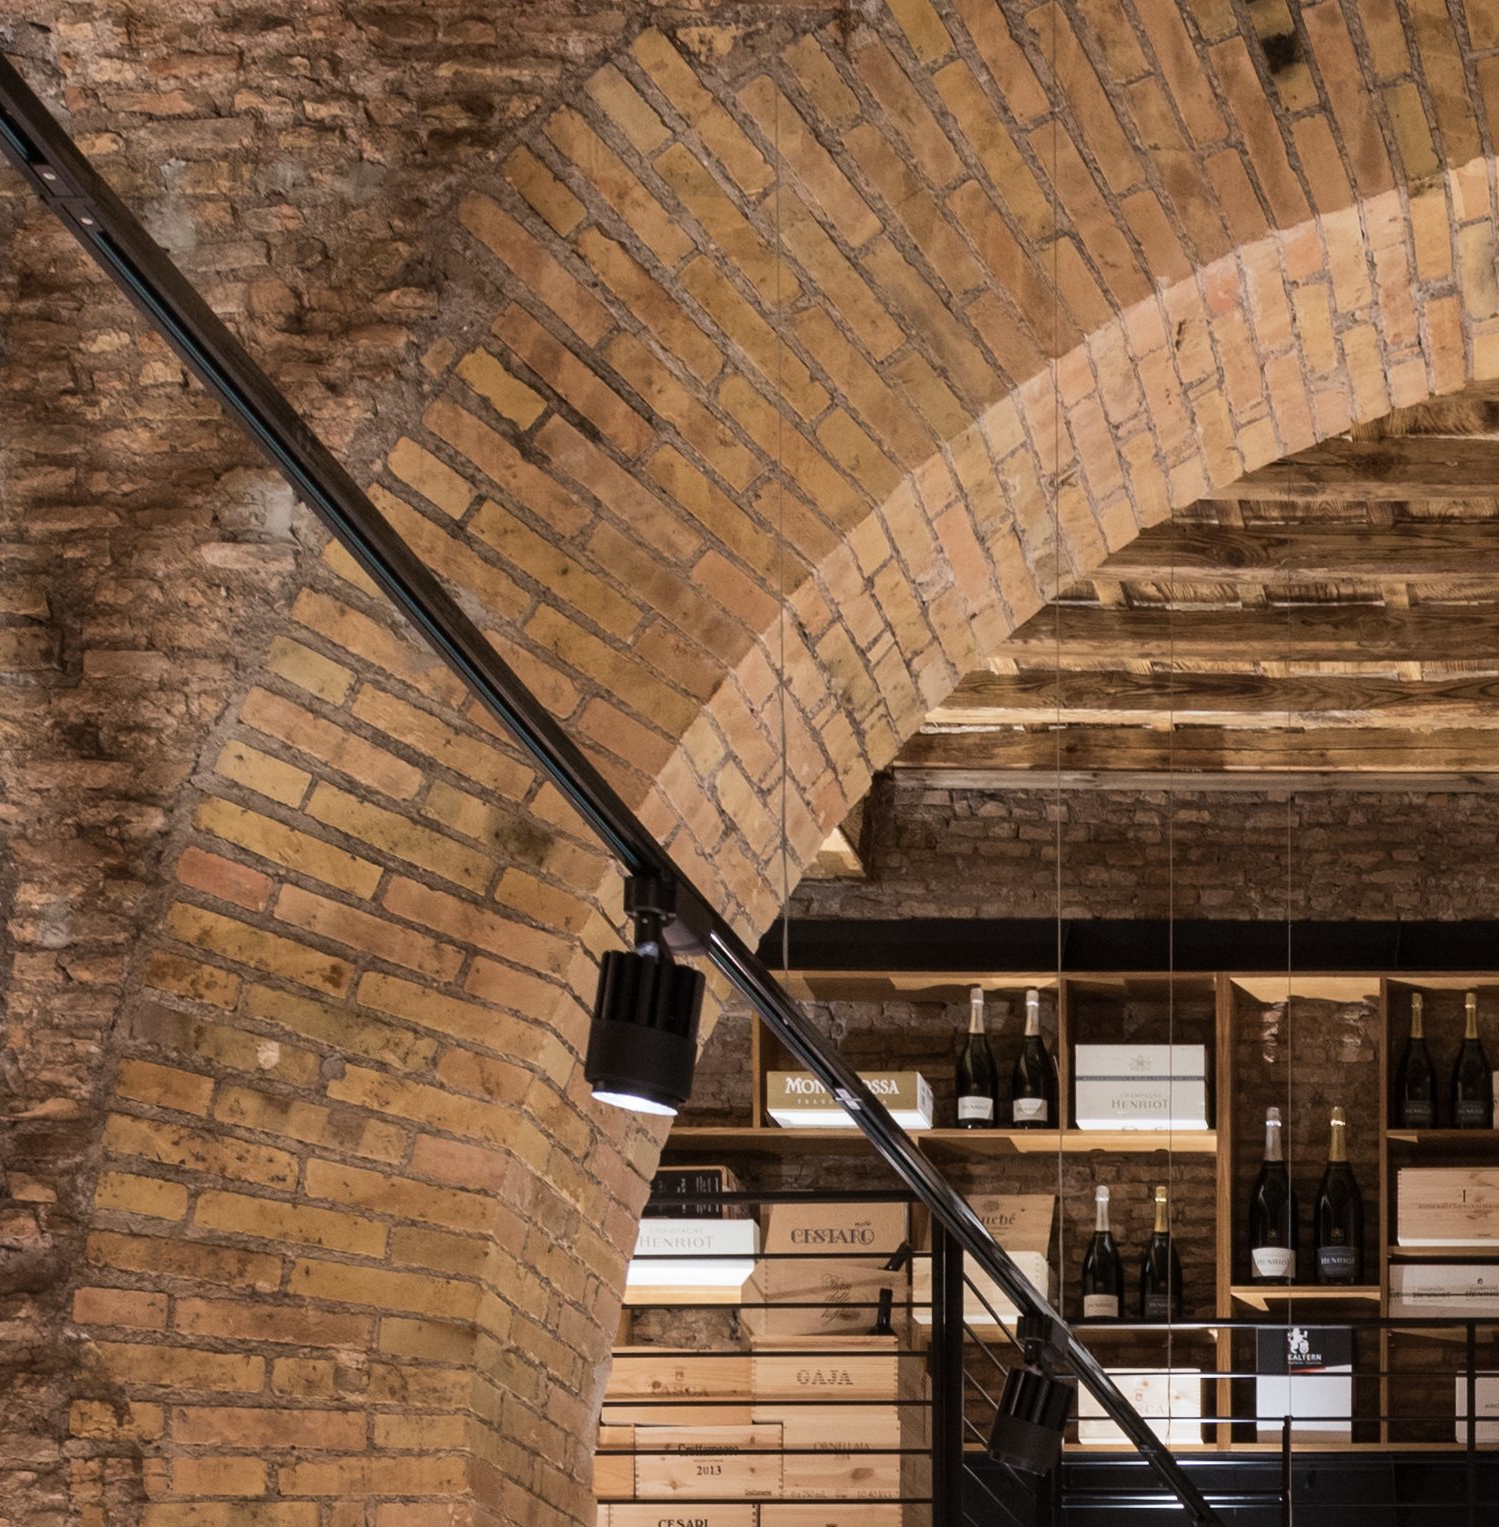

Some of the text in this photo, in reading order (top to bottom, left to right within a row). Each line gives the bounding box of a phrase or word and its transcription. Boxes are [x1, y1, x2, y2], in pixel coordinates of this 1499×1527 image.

[1111, 1099, 1168, 1110] HENRIOT
[639, 1235, 714, 1249] HENRIOT
[796, 1369, 854, 1386] GAJA
[696, 1465, 722, 1476] 2013
